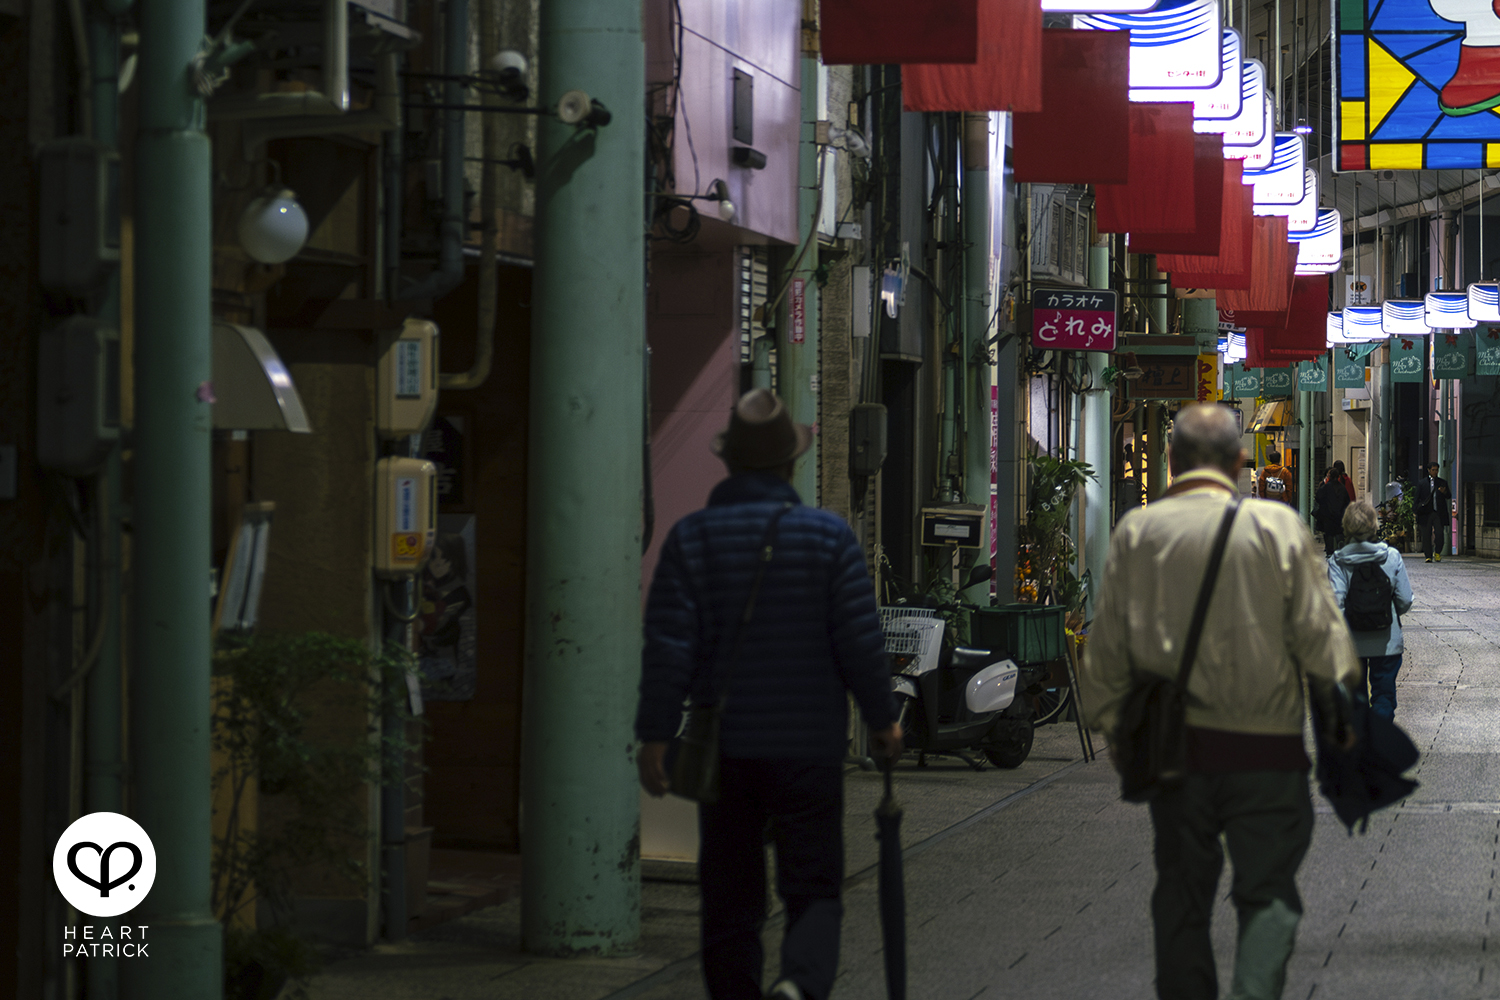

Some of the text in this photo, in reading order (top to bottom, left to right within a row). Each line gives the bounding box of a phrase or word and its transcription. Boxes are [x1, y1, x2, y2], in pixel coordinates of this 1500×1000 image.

[1047, 294, 1103, 308] カラオケ
[1038, 316, 1112, 342] どれみ
